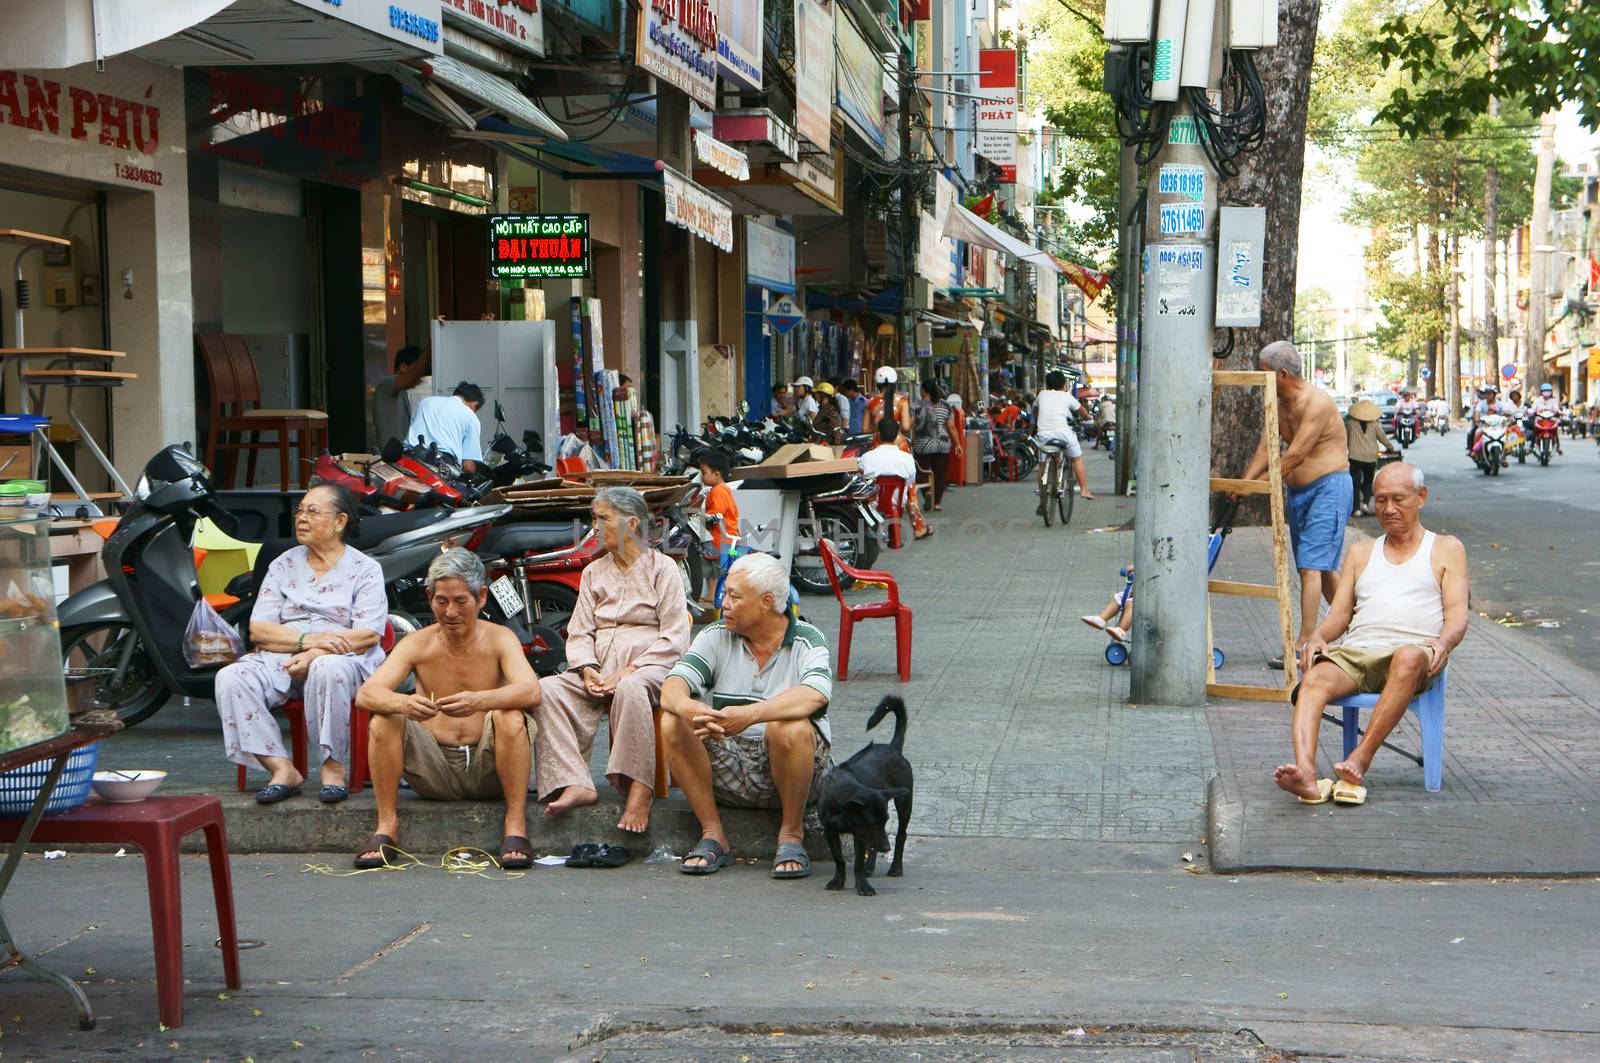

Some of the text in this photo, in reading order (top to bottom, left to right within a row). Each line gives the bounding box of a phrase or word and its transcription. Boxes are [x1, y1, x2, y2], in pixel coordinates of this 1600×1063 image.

[69, 85, 160, 155] PHÚ
[981, 109, 1013, 120] PHÁT
[496, 219, 583, 236] NỘI THẤT CAO CẤP
[498, 233, 582, 263] ĐẠI THUẬN
[527, 266, 540, 274] GIA
